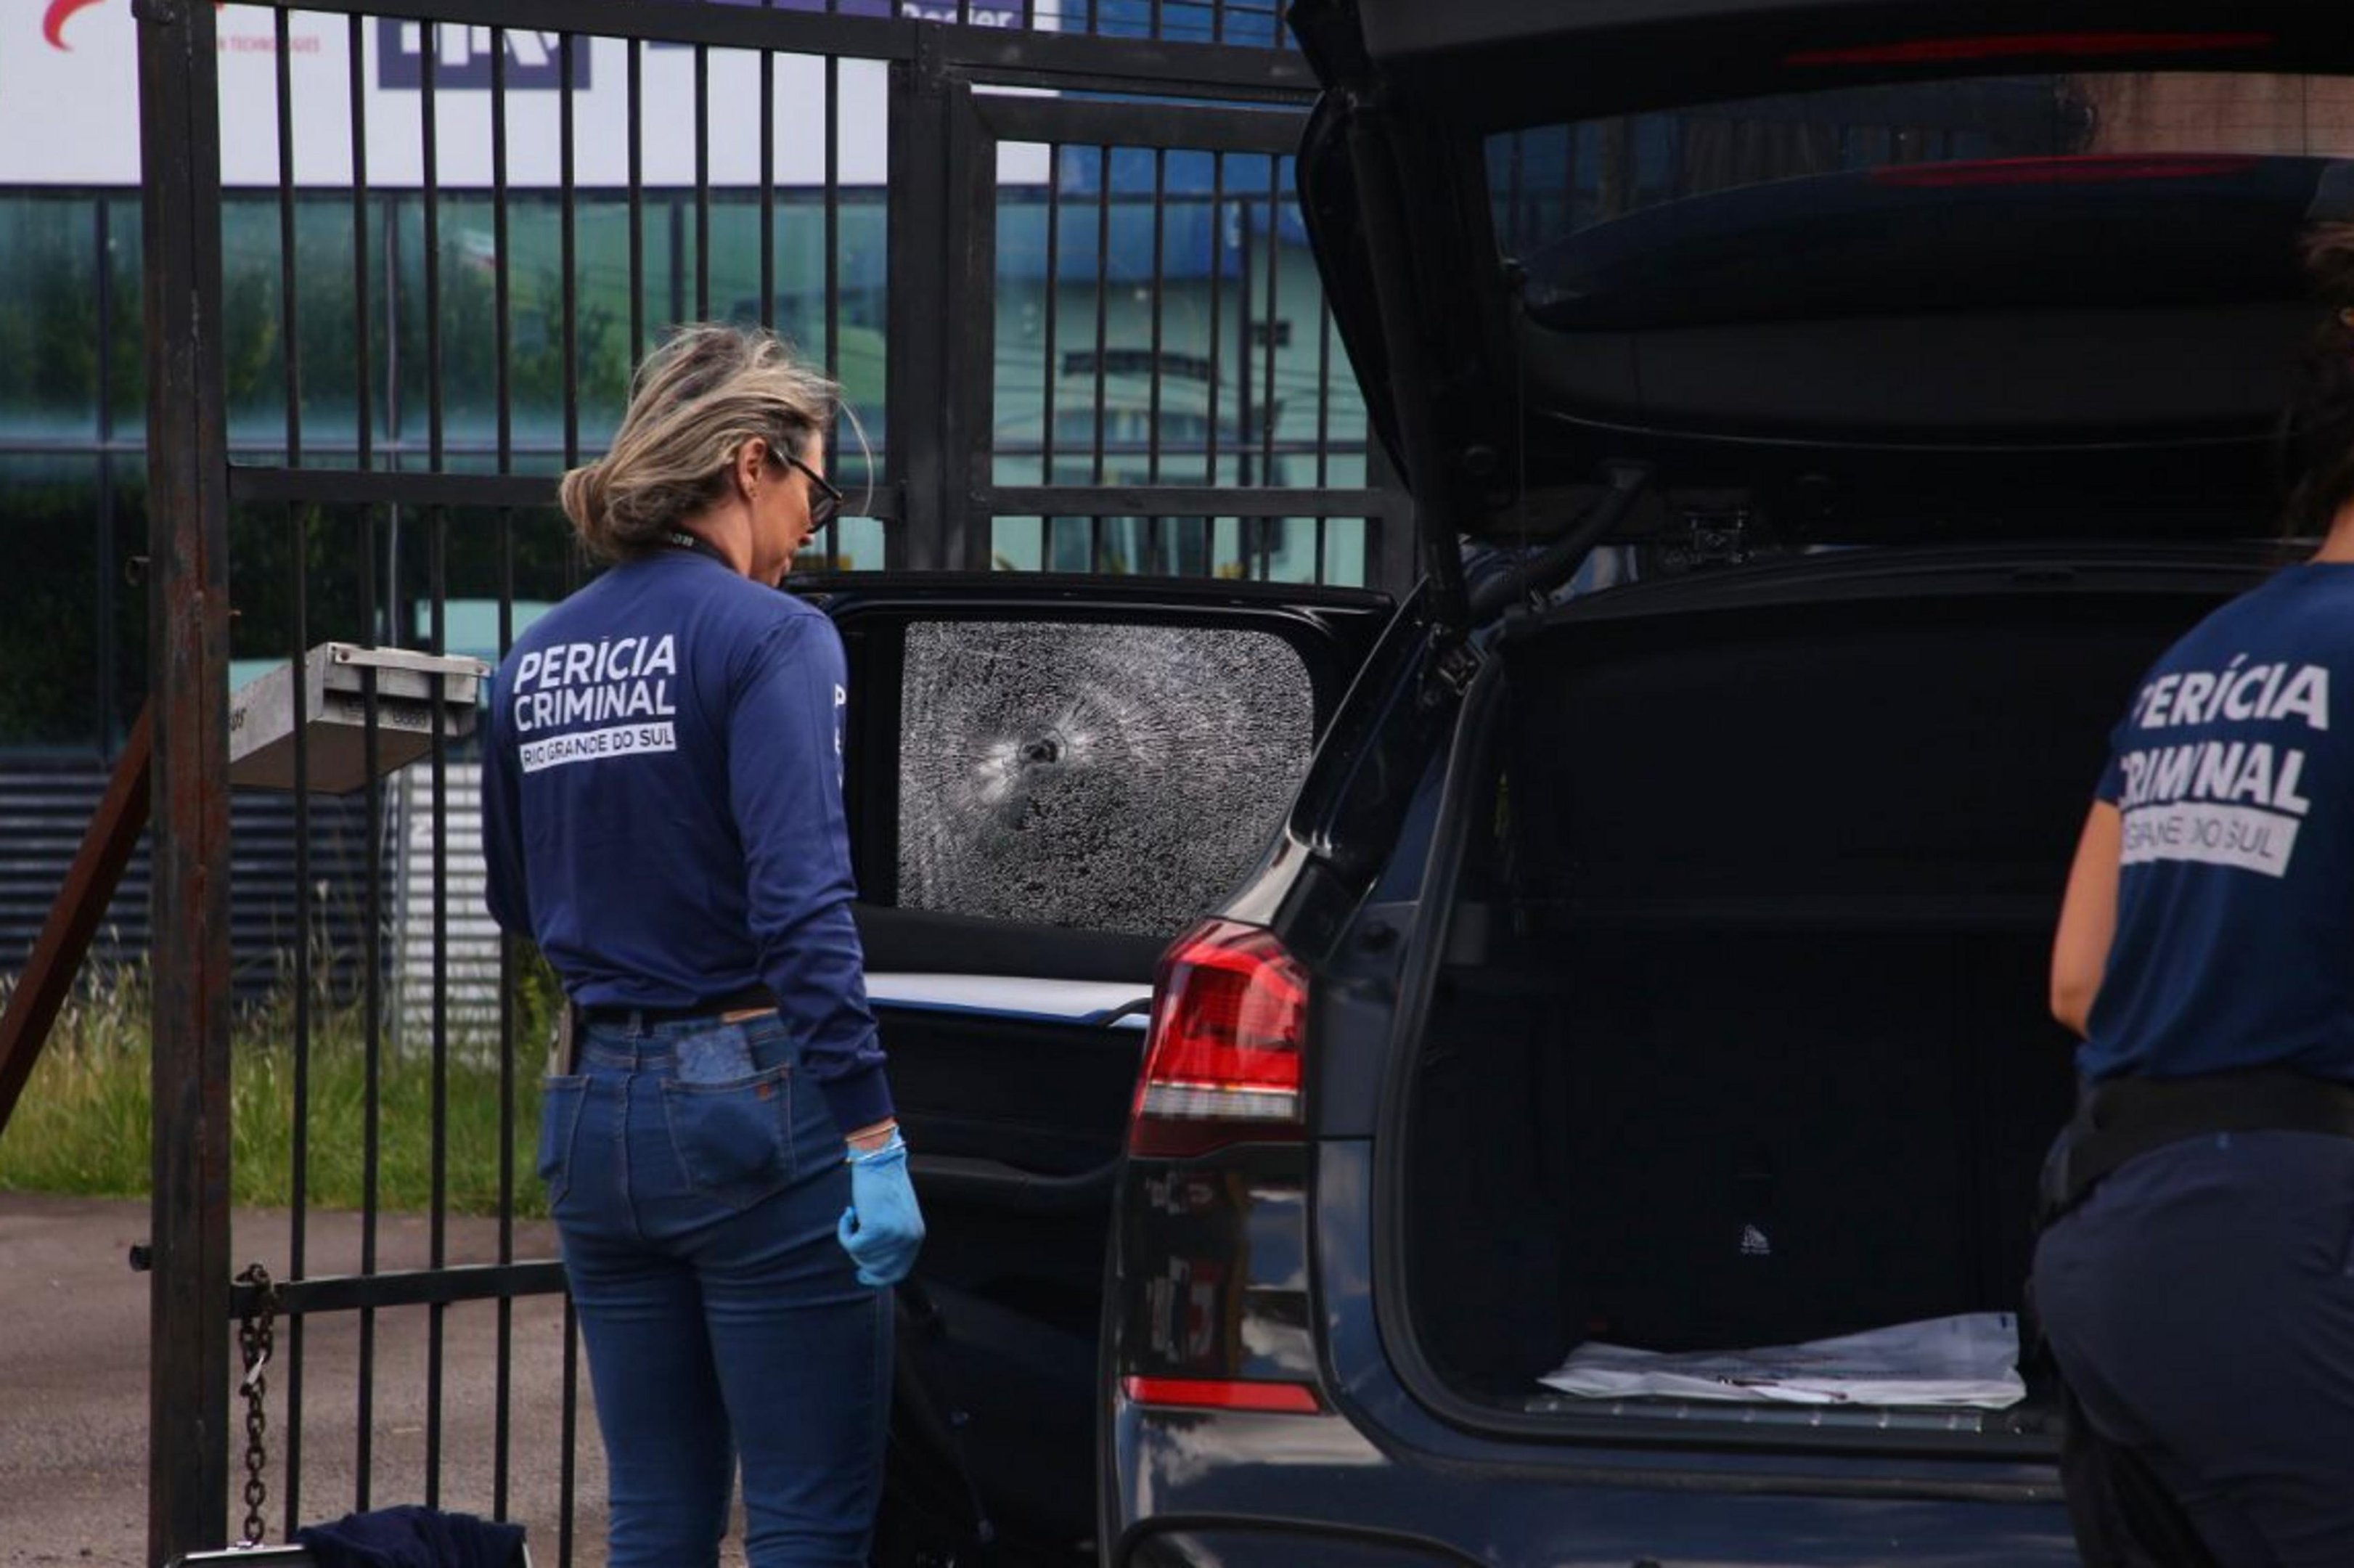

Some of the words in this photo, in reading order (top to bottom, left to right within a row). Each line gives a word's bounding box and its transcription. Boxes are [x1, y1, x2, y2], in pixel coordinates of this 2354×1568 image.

[230, 37, 319, 53] TECHNOGIES
[513, 634, 677, 694] PERÍCIA
[514, 679, 676, 732] CRIMINAL
[547, 734, 608, 760] GRANDE
[613, 730, 634, 750] DO
[639, 729, 674, 747] SUL
[2119, 742, 2310, 816] RIMINAL
